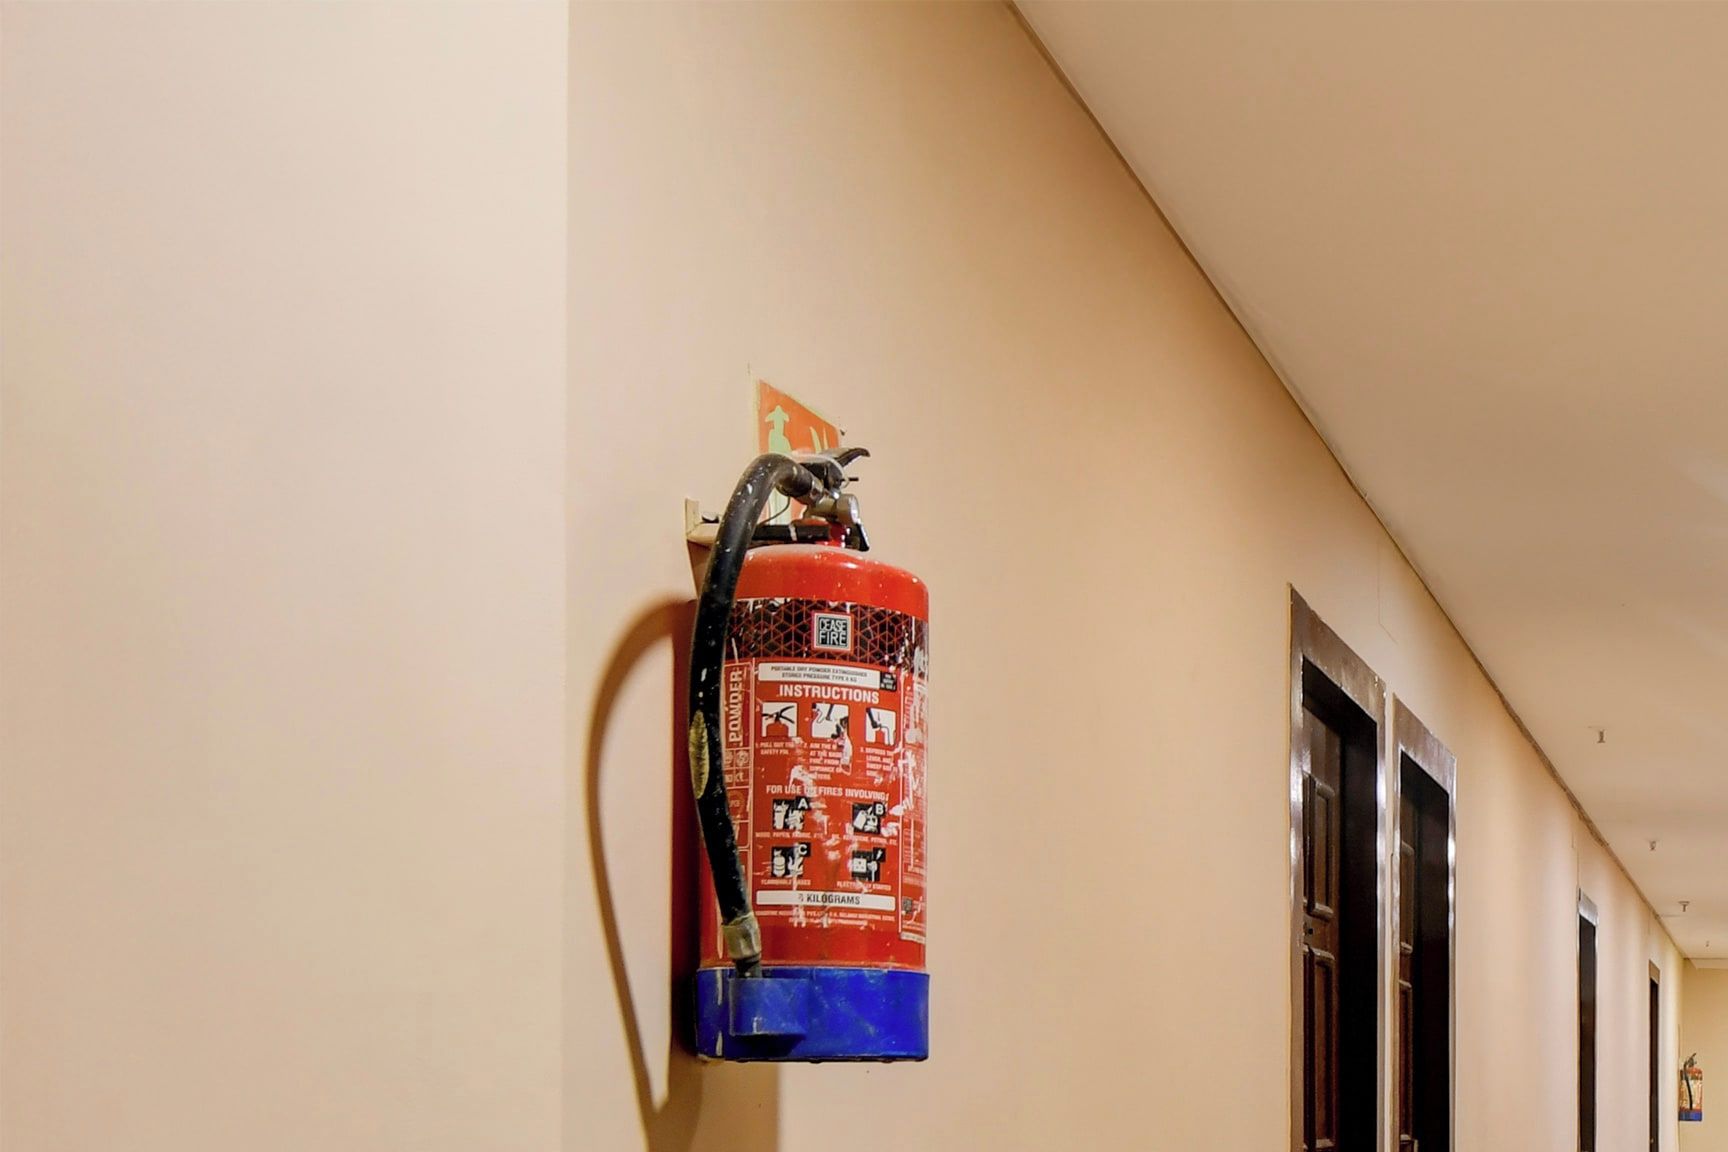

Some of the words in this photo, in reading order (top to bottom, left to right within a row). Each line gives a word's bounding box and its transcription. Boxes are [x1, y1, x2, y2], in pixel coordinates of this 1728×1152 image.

[819, 618, 847, 632] CEASE
[819, 631, 847, 646] FIRE
[779, 684, 880, 705] INSTRUCTIONS
[728, 669, 743, 743] POWDER
[766, 785, 783, 794] FOR
[785, 785, 801, 795] USE
[818, 786, 843, 797] FIRES
[798, 798, 808, 809] A
[876, 803, 884, 815] B
[798, 844, 807, 855] C
[806, 893, 861, 905] KILOGRAMS
